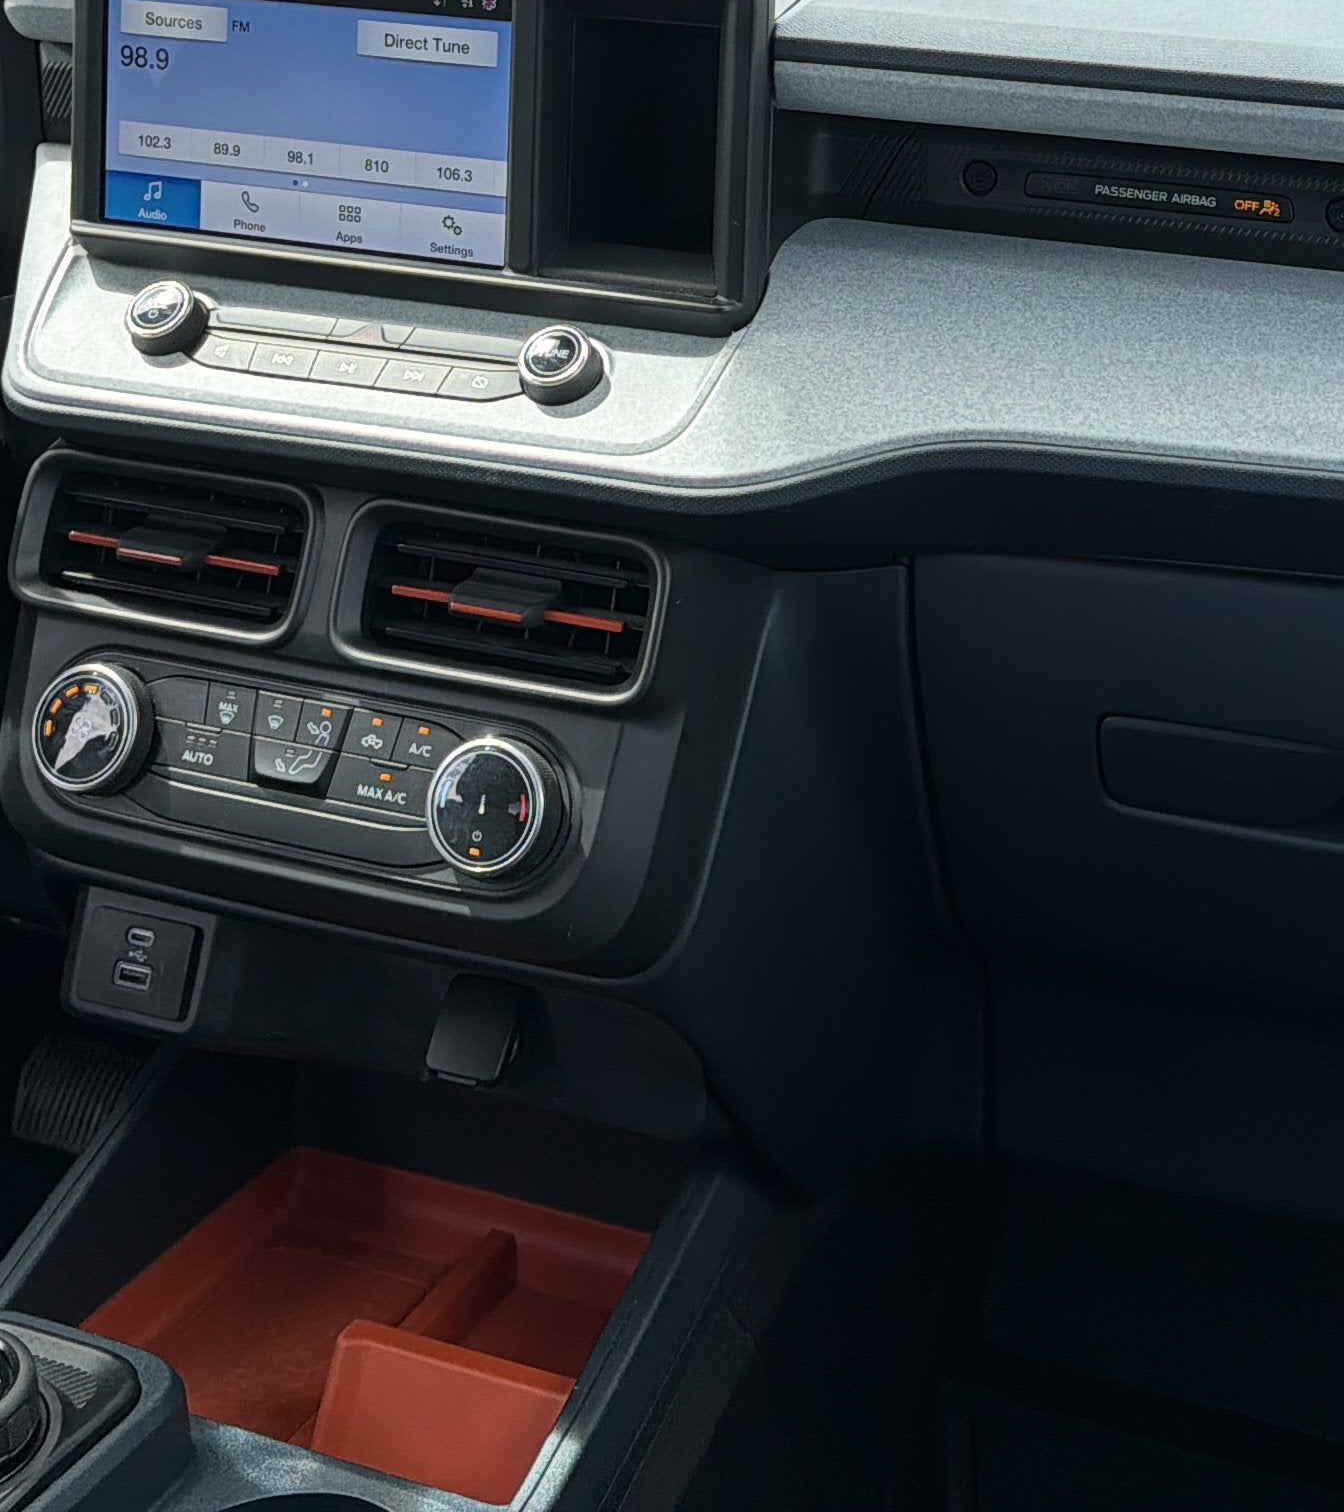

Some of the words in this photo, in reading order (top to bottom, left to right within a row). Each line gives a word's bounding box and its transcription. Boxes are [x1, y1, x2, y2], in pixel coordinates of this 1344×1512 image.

[144, 11, 203, 32] Sources
[231, 20, 250, 34] FM
[383, 33, 428, 54] Direct
[431, 37, 470, 57] Tune
[119, 44, 169, 73] 98.9
[137, 133, 172, 151] 102.3
[213, 141, 241, 157] 89.9
[287, 150, 315, 167] 98.1
[364, 158, 389, 174] 810
[435, 166, 473, 184] 106.3
[1094, 183, 1168, 202] PASSENGER
[1171, 192, 1217, 208] AIRBAG
[1234, 198, 1259, 212] OFF
[138, 207, 168, 222] Audio
[233, 219, 266, 235] Phone
[335, 230, 363, 246] Apps
[430, 242, 474, 259] Settings
[218, 700, 239, 713] MAX
[181, 749, 215, 767] AUTO
[407, 740, 432, 759] A/C
[356, 782, 381, 801] MAX
[381, 787, 407, 806] A/C
